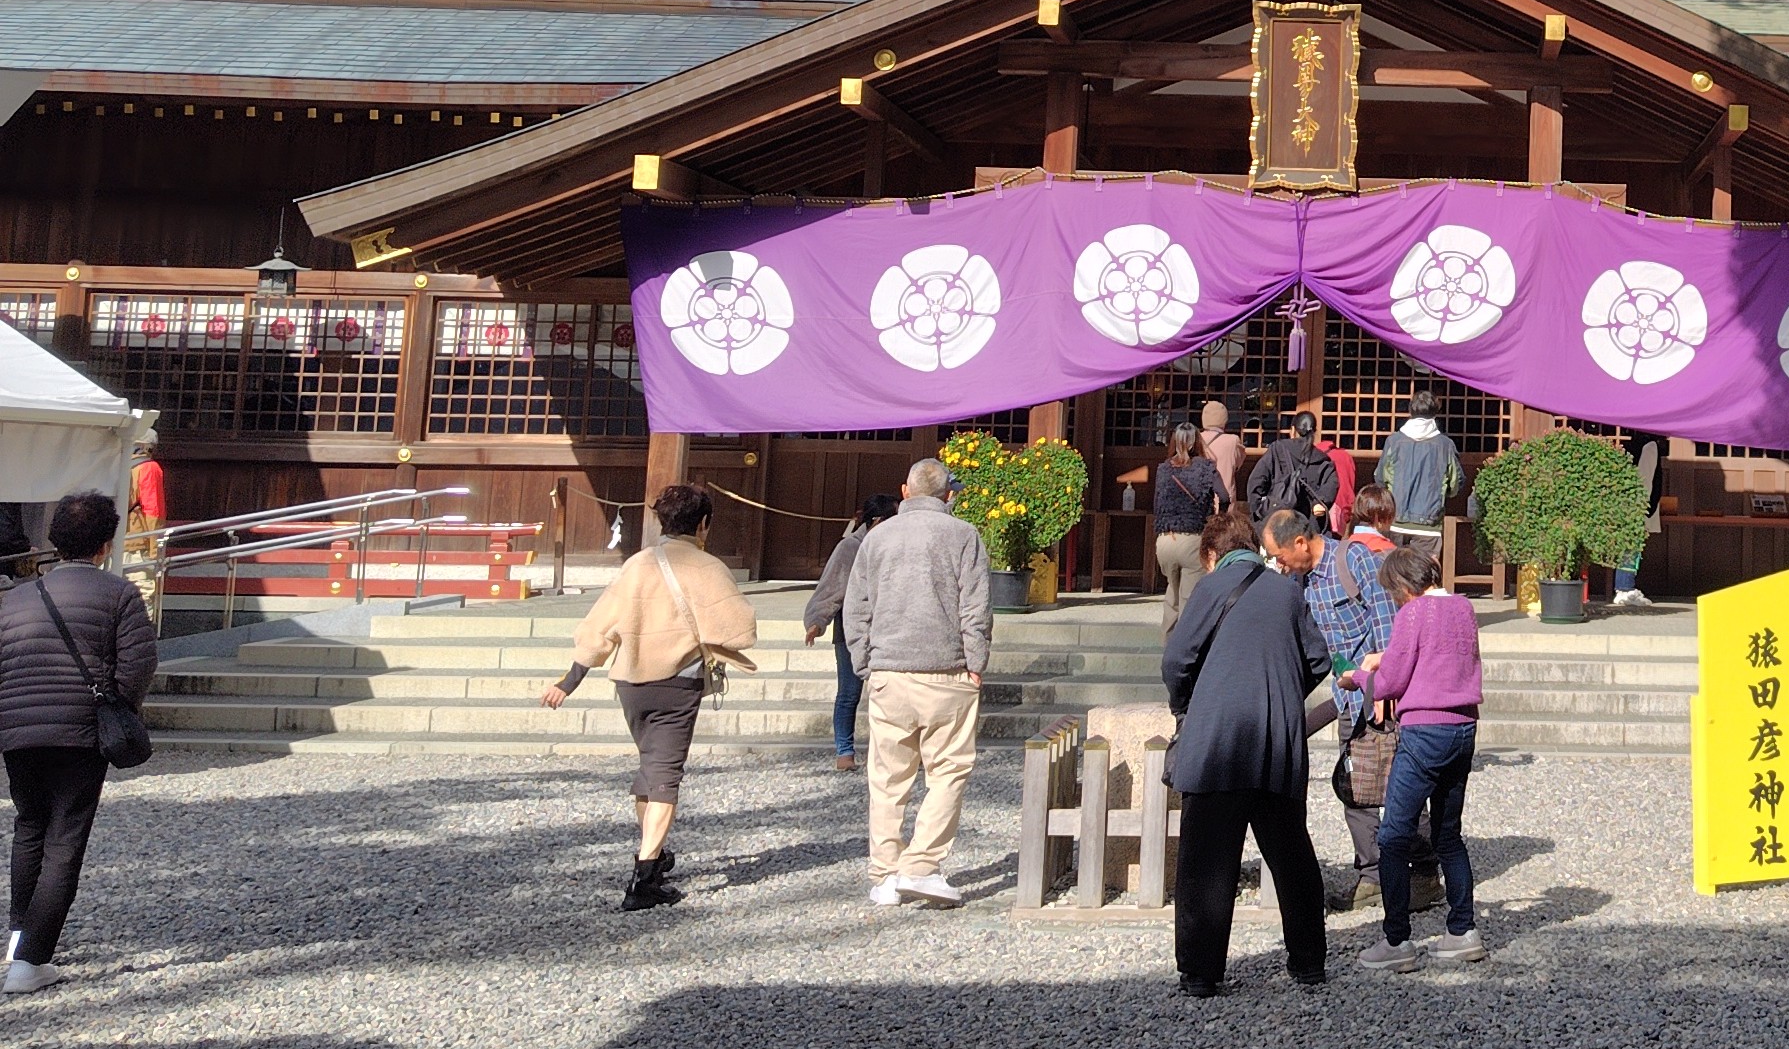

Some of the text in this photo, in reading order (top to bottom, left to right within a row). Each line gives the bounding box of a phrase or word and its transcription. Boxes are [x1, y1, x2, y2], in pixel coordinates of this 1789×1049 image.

[1745, 627, 1787, 867] 猿田彦神社
